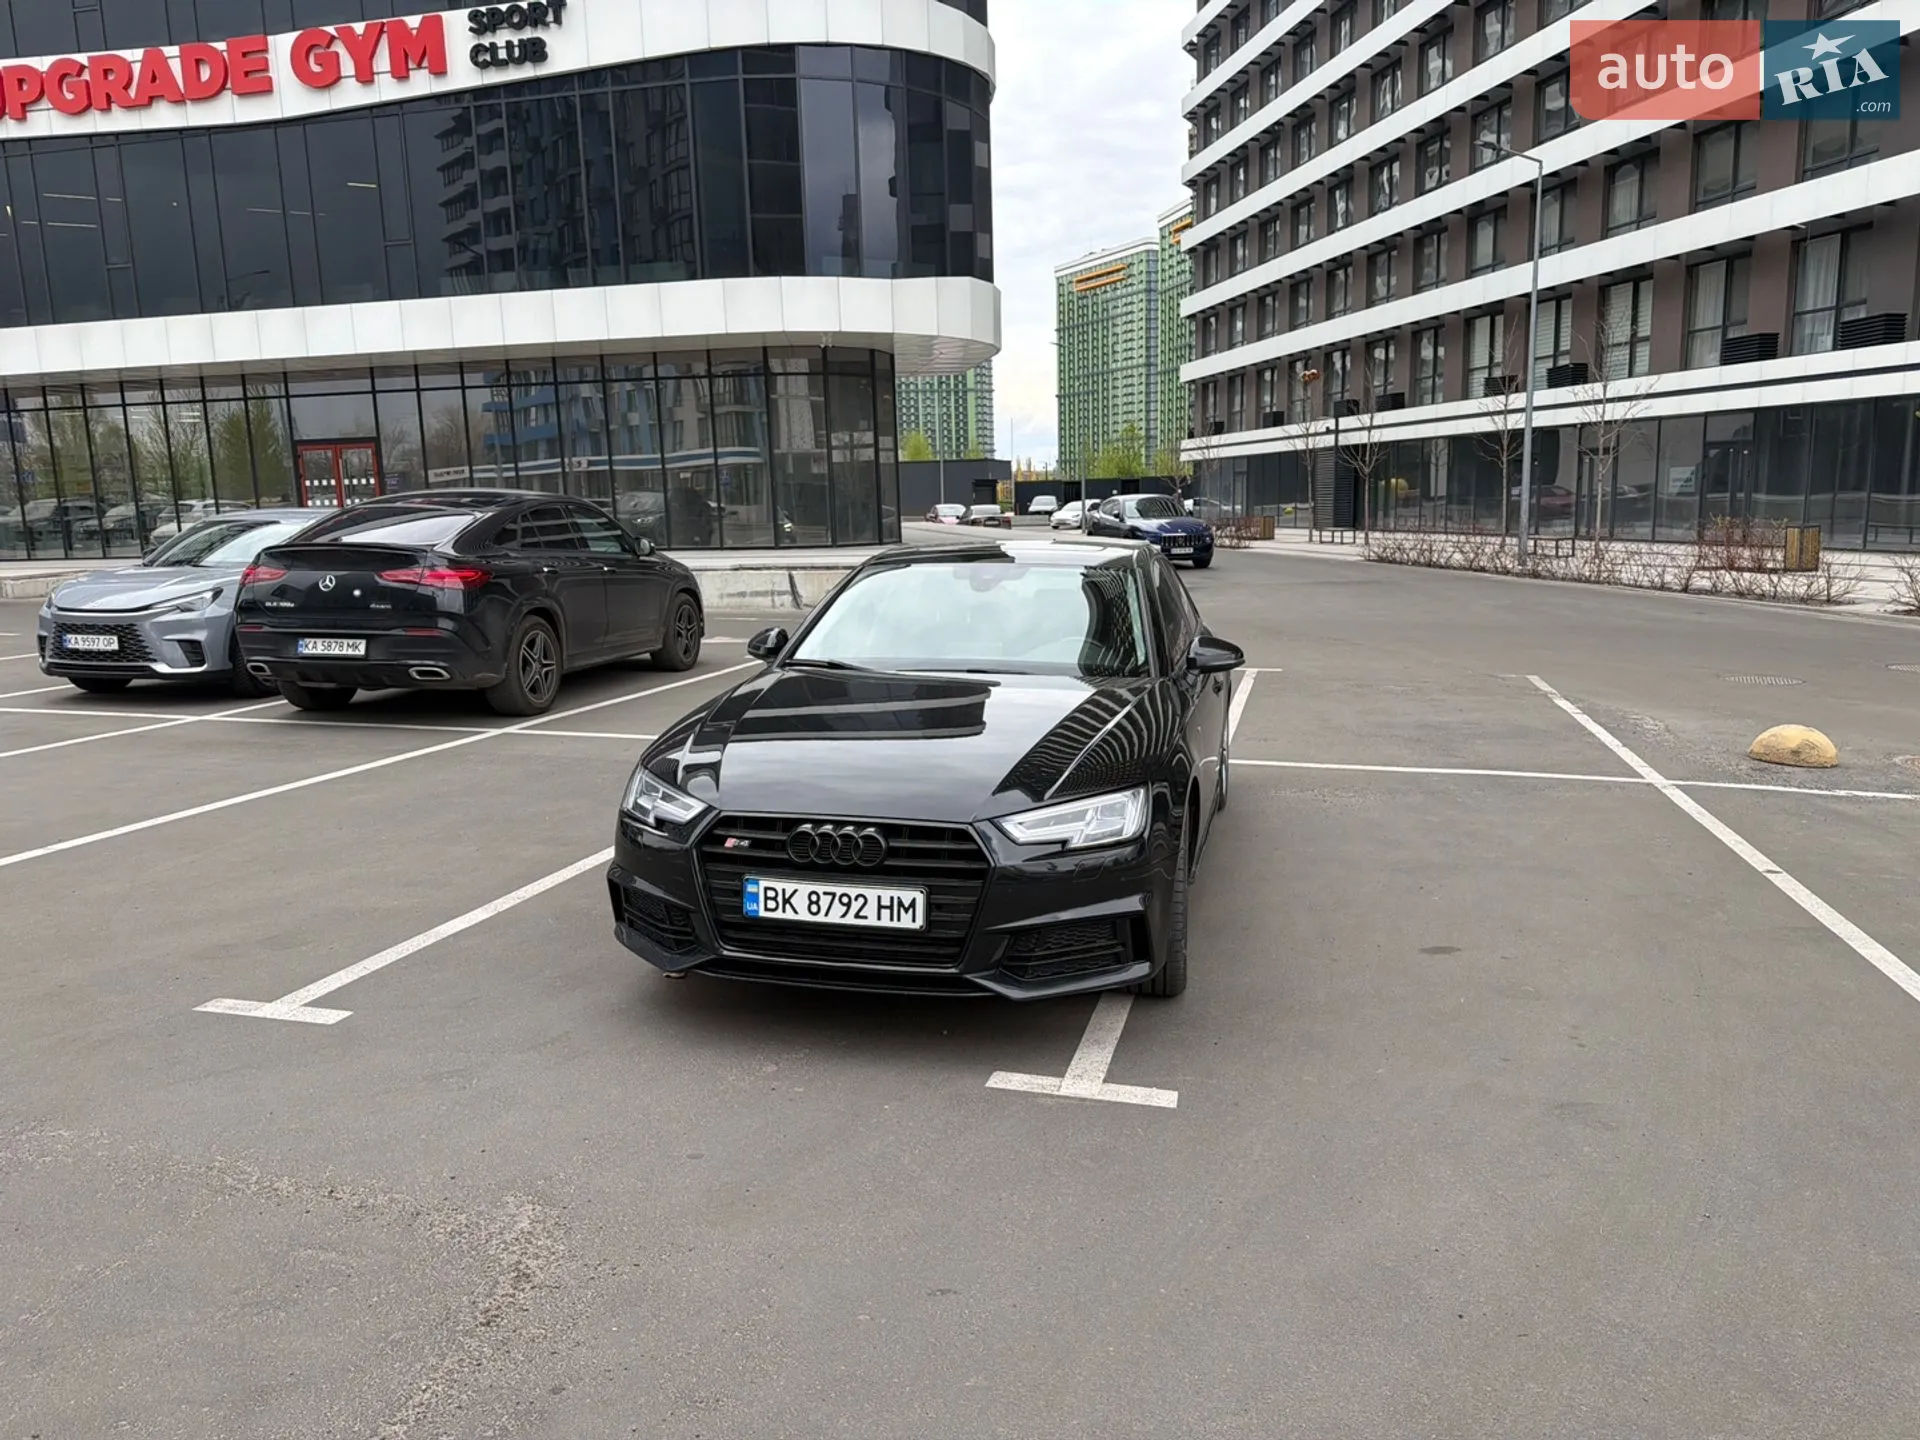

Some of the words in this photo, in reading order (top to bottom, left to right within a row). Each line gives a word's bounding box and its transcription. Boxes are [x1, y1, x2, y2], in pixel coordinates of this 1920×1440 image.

[468, 0, 566, 35] SPORT
[0, 35, 273, 120] PGRADE
[290, 13, 447, 89] GYM
[469, 37, 548, 69] CLUB
[304, 640, 318, 652] KA
[321, 640, 345, 652] 5878
[346, 641, 363, 653] MK
[746, 902, 759, 911] UA
[763, 886, 800, 914] BK
[807, 890, 868, 920] 8792
[876, 894, 916, 923] HM
